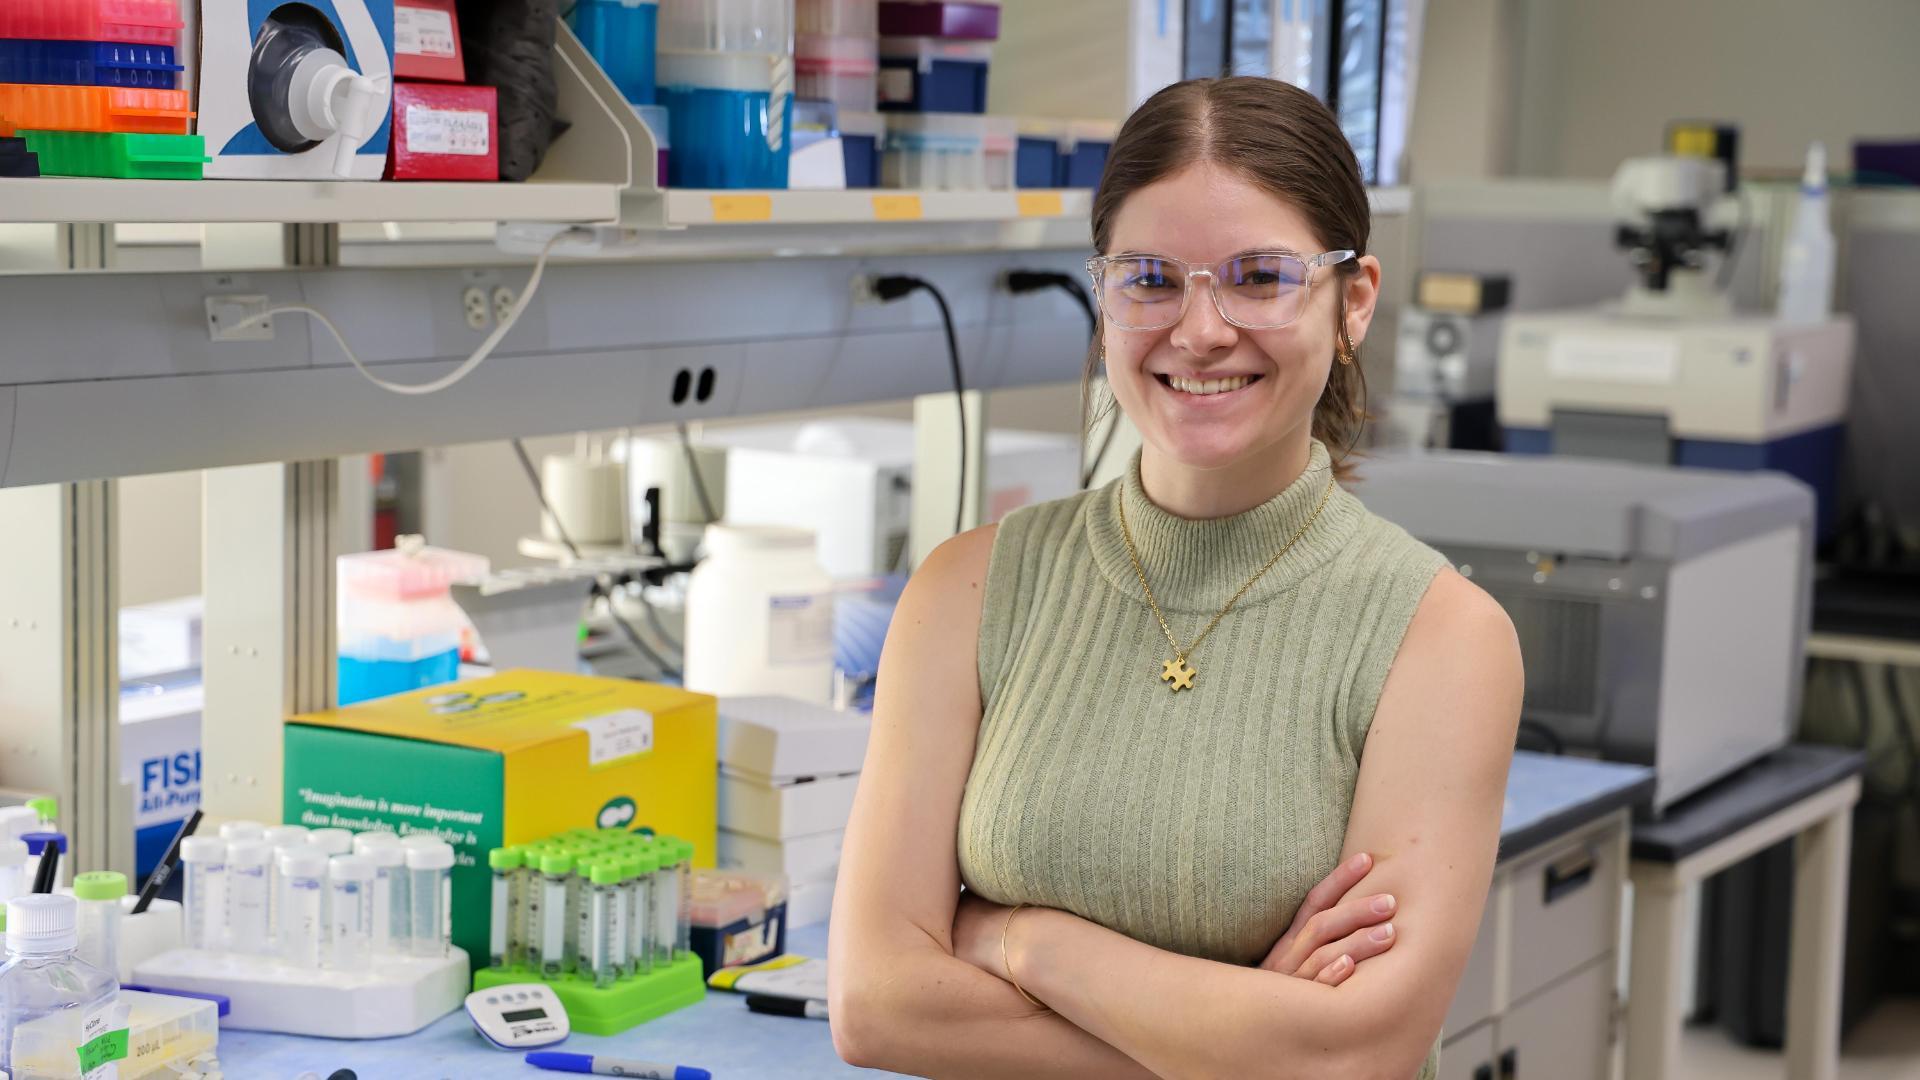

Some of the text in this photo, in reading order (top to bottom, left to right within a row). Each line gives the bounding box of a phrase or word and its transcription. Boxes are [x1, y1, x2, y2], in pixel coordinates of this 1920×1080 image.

[377, 798, 389, 813] is
[391, 802, 422, 817] more
[423, 804, 483, 825] important
[302, 811, 330, 827] than
[466, 831, 477, 845] is
